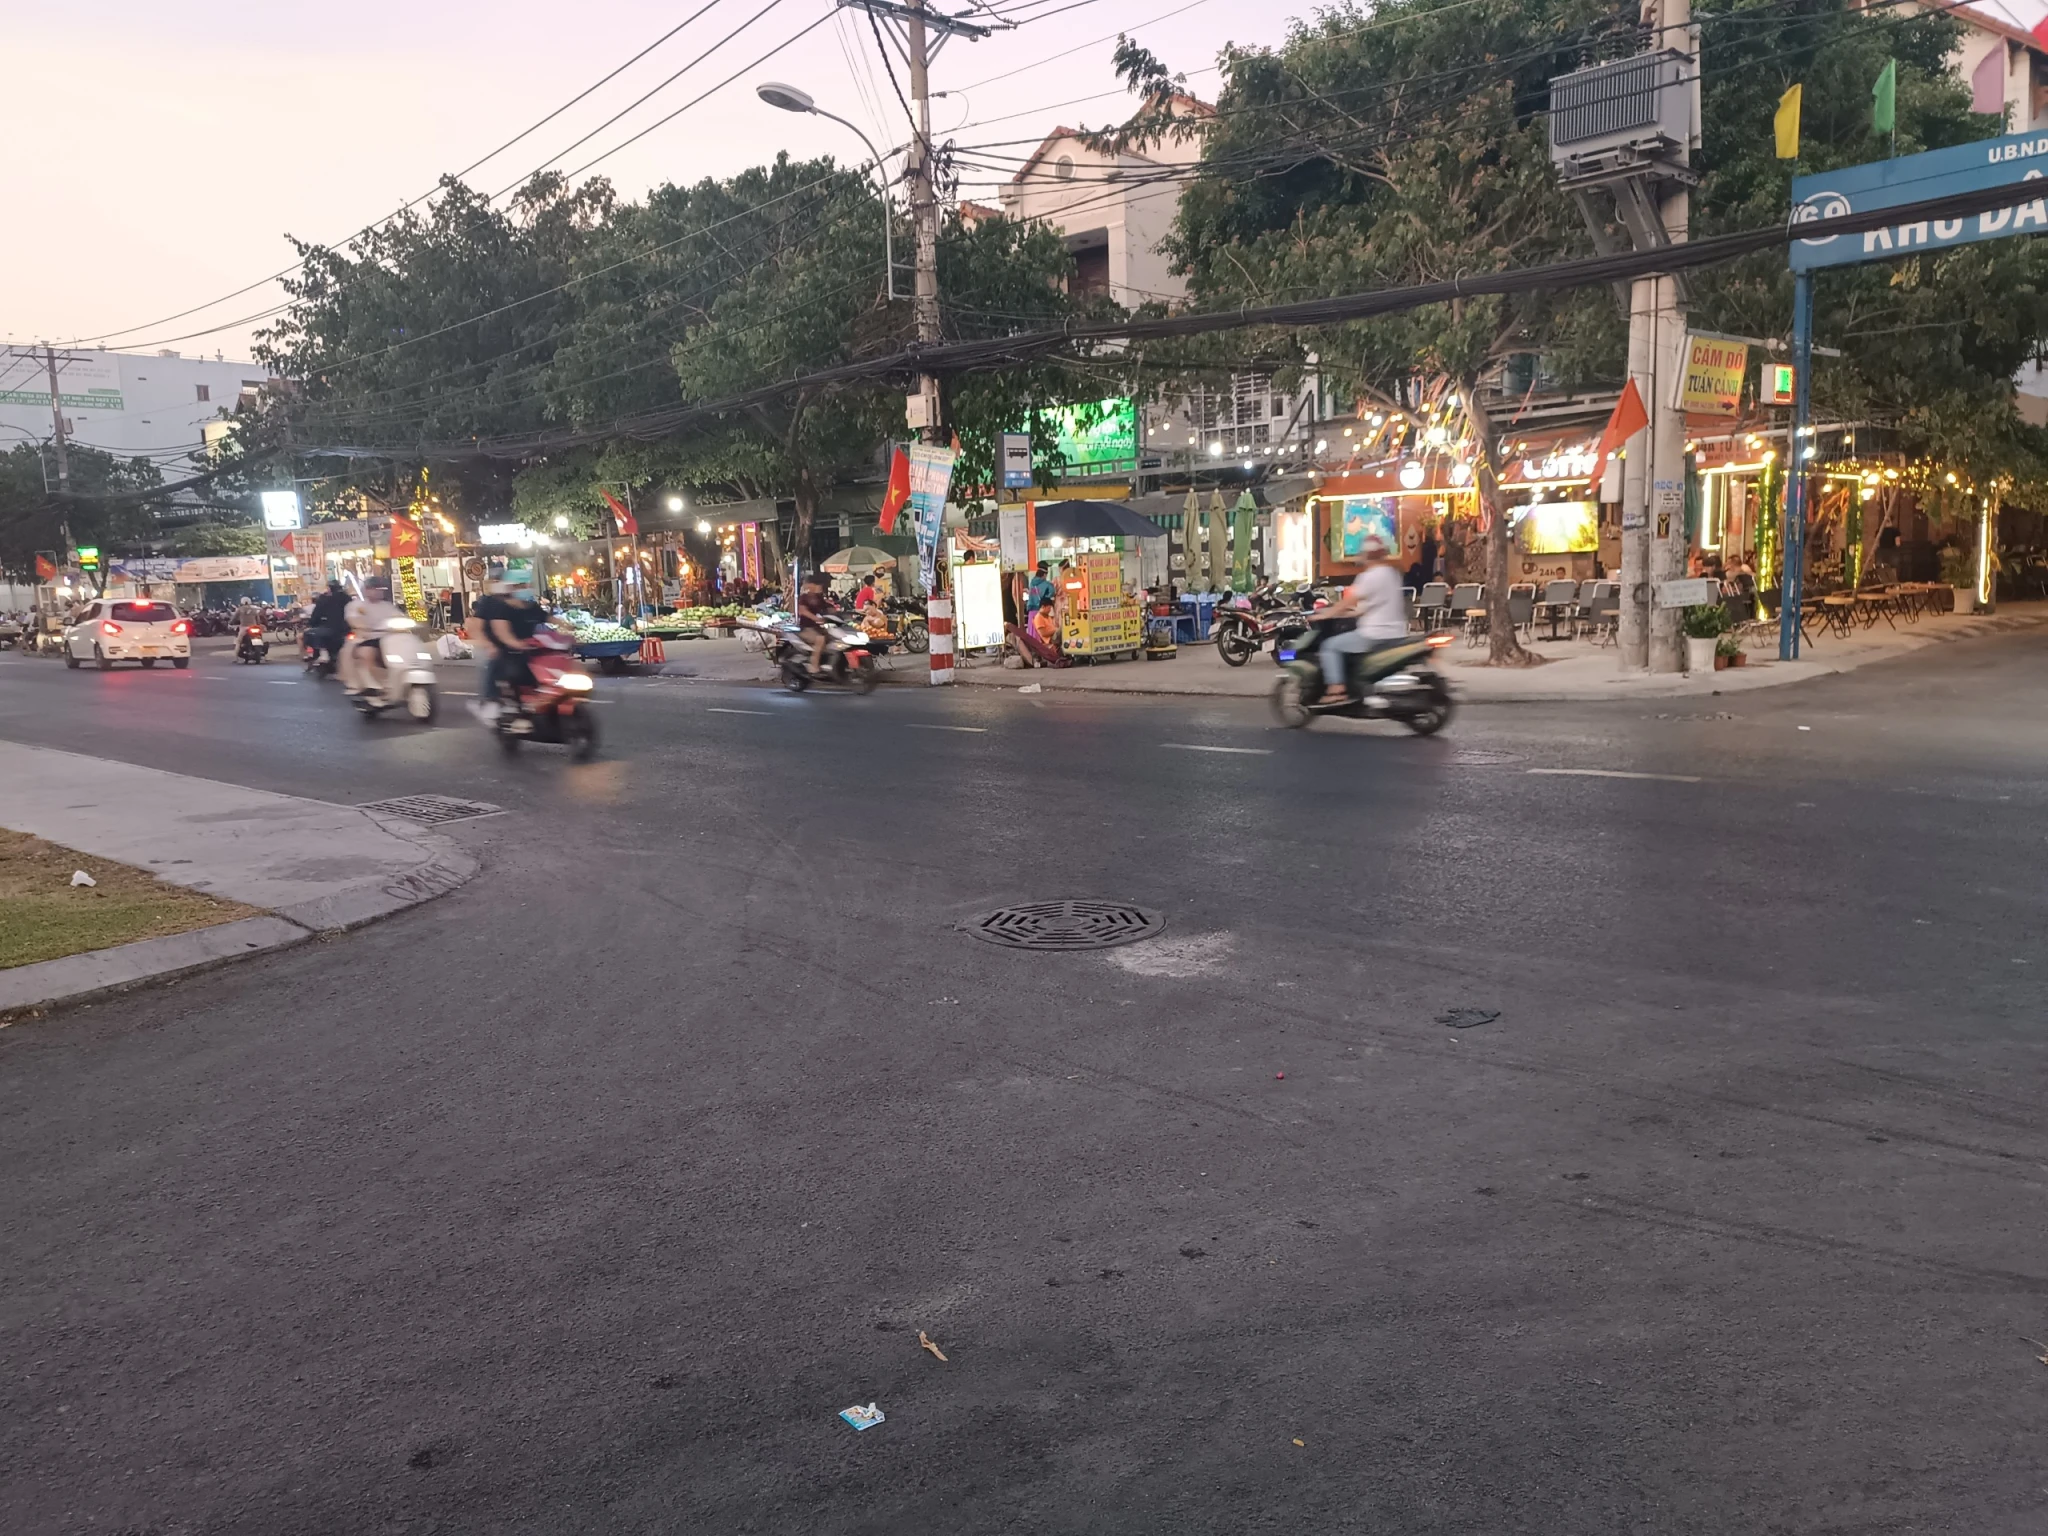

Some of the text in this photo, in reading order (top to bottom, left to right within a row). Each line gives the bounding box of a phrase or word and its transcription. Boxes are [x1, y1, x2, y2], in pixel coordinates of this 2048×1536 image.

[1692, 341, 1743, 369] CẦM ĐỒ
[1688, 369, 1713, 393] TUẤN
